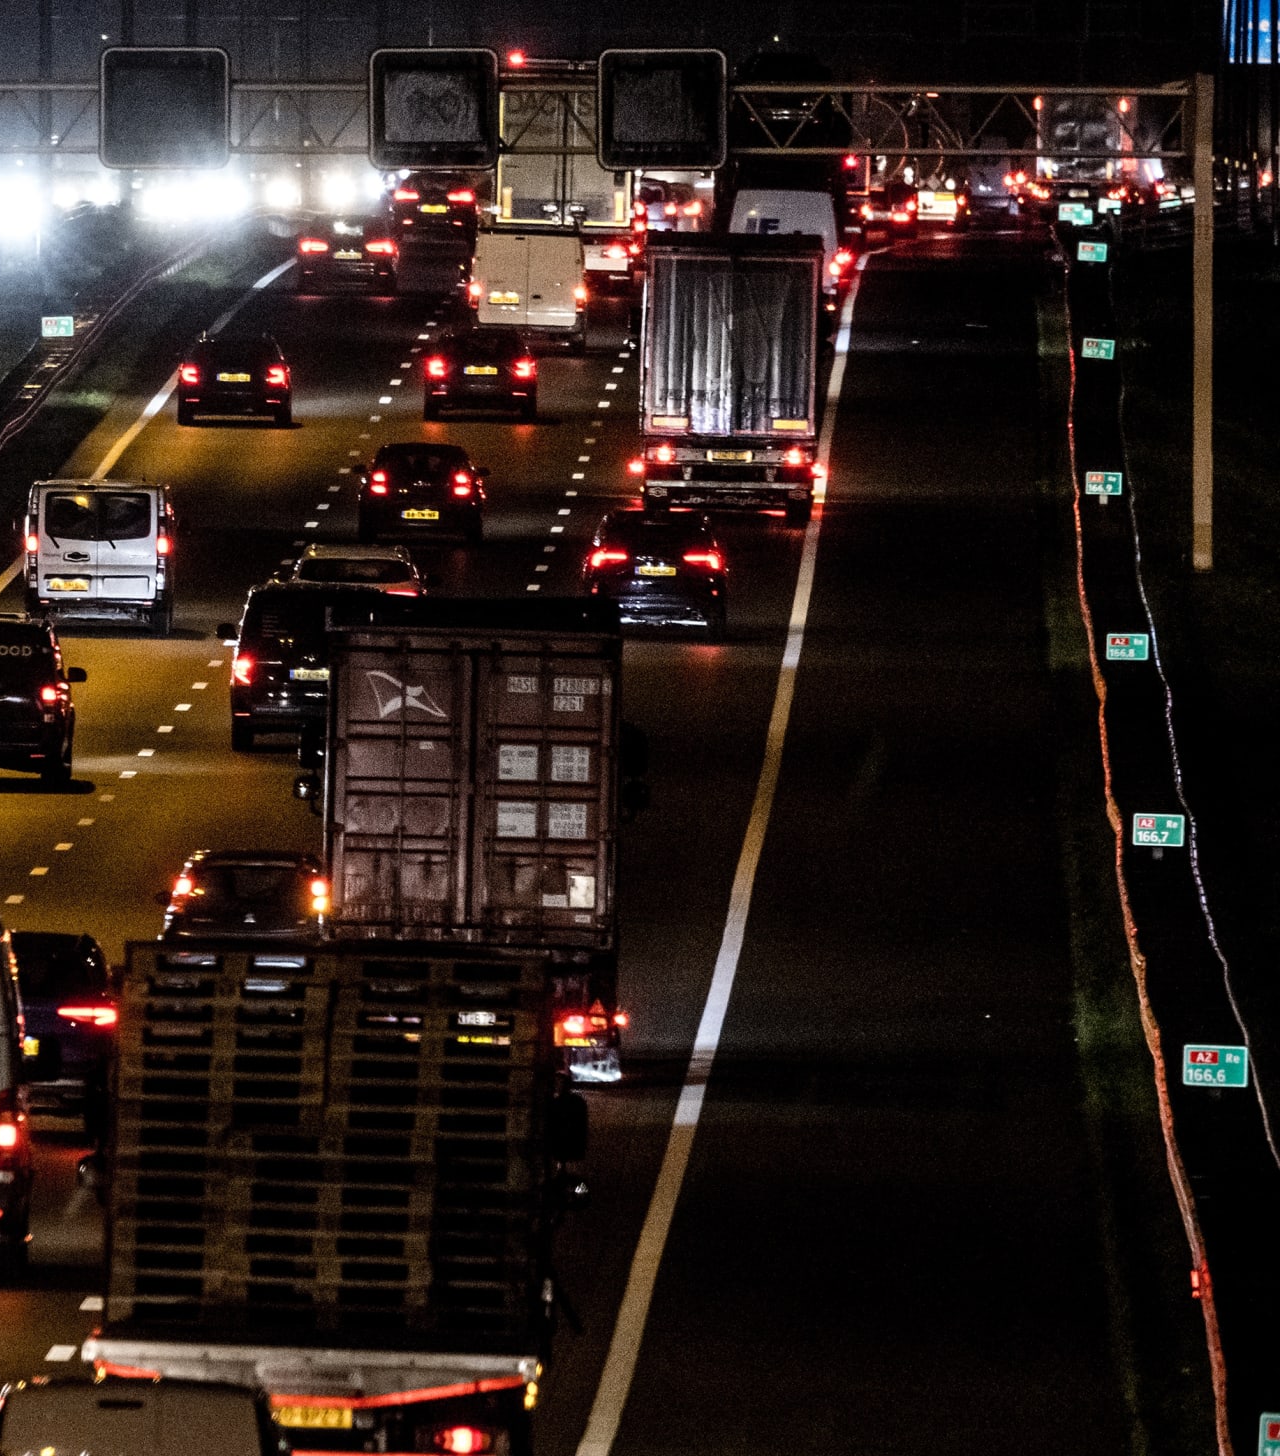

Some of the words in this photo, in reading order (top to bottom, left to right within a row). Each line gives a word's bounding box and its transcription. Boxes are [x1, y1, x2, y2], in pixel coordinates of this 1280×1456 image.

[1140, 819, 1153, 827] A2
[1196, 1052, 1212, 1063] A2
[1225, 1053, 1241, 1063] Re
